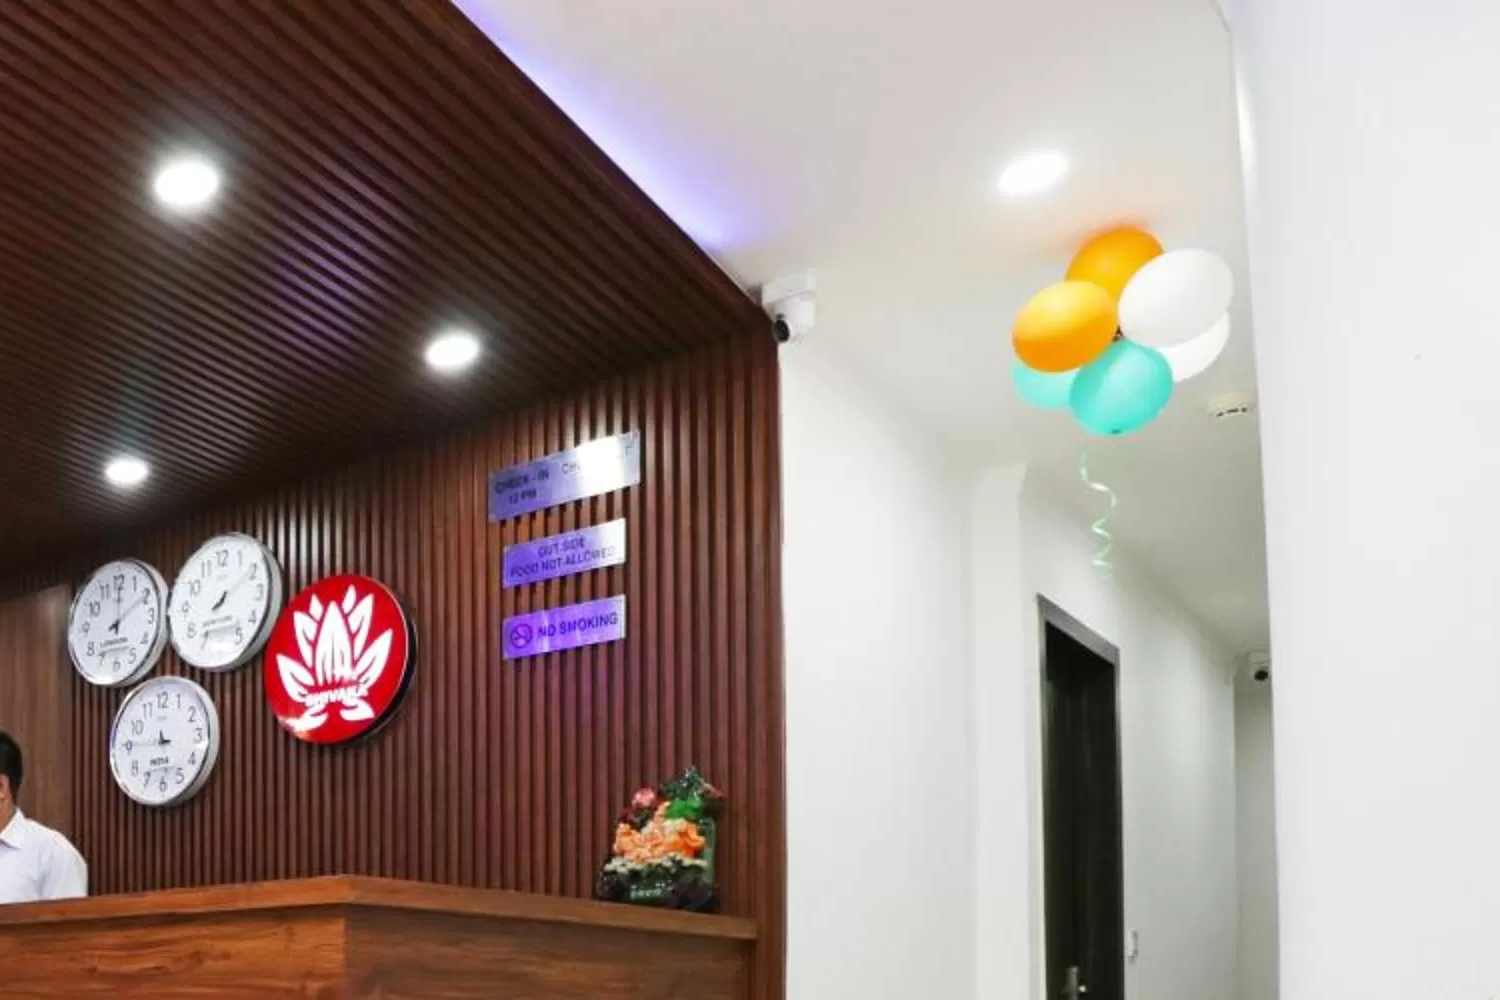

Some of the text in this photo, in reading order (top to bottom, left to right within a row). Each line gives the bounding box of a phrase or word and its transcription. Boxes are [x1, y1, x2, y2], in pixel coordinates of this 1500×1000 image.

[216, 549, 228, 568] 12
[538, 543, 559, 558] OUT
[201, 560, 212, 578] 11
[249, 563, 257, 580] 2
[542, 558, 562, 571] NOT
[113, 574, 125, 591] 12
[188, 580, 200, 596] 10
[100, 584, 110, 600] 11
[142, 588, 150, 604] 2
[255, 583, 264, 601] 3
[89, 601, 100, 617] 10
[148, 607, 154, 624] 3
[182, 600, 190, 618] 9
[248, 609, 256, 624] 4
[83, 622, 90, 637] 9
[187, 621, 196, 639] 8
[538, 612, 617, 637] NO SMOKING
[140, 632, 148, 644] 4
[201, 630, 208, 649] 7
[234, 627, 243, 645] 5
[87, 642, 94, 656] 8
[128, 648, 136, 664] 5
[98, 651, 107, 665] 7
[113, 657, 120, 672] 6
[156, 692, 168, 709] 12
[142, 702, 152, 719] 11
[188, 706, 196, 722] 2
[131, 720, 144, 736] 10
[194, 727, 203, 743] 3
[125, 740, 132, 756] 9
[188, 751, 196, 765] 4
[132, 759, 138, 777] 8
[175, 768, 184, 784] 5
[144, 771, 151, 788] 7
[159, 776, 167, 792] 6
